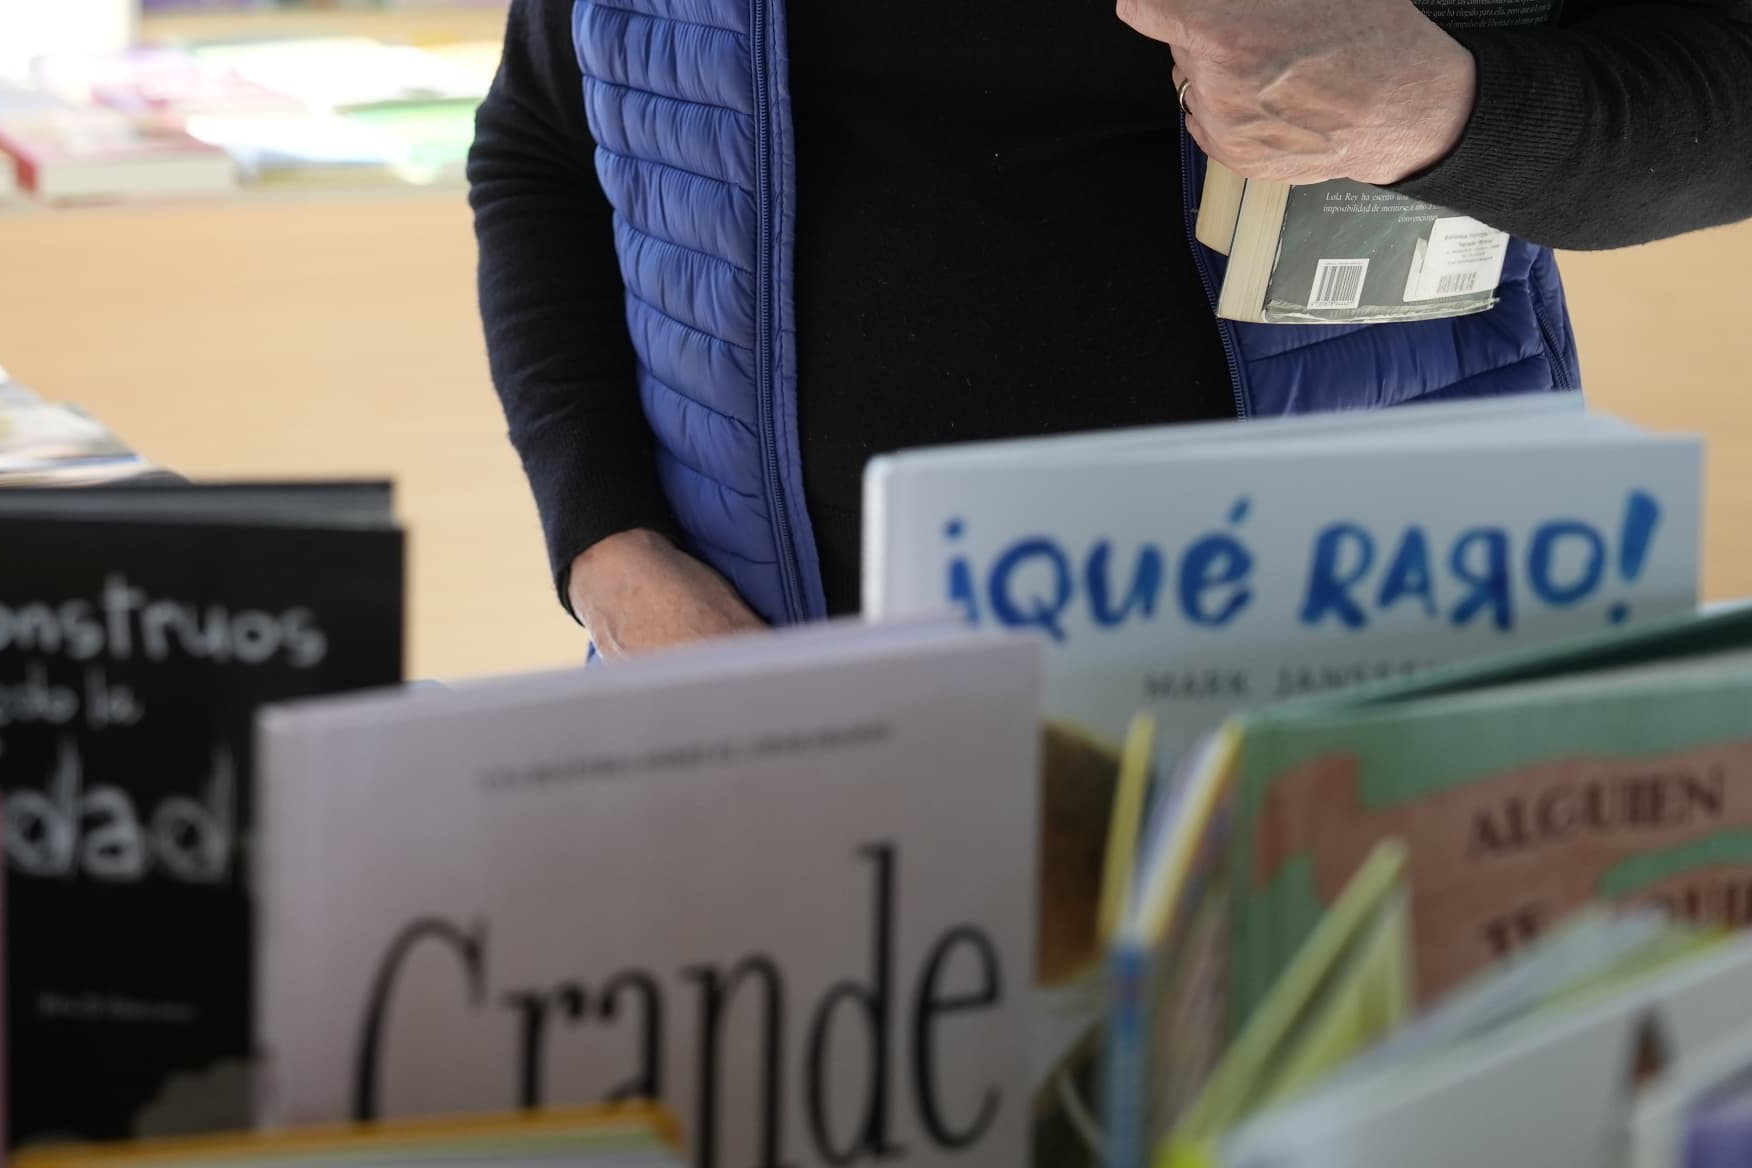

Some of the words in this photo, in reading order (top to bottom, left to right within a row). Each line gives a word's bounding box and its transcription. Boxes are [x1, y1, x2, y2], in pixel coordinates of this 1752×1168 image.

[1326, 192, 1342, 201] Lola
[1345, 192, 1357, 203] Rey
[1361, 192, 1370, 201] ha
[1371, 203, 1379, 212] de
[1301, 489, 1662, 632] RARO!
[1464, 760, 1725, 863] ALGUIEN
